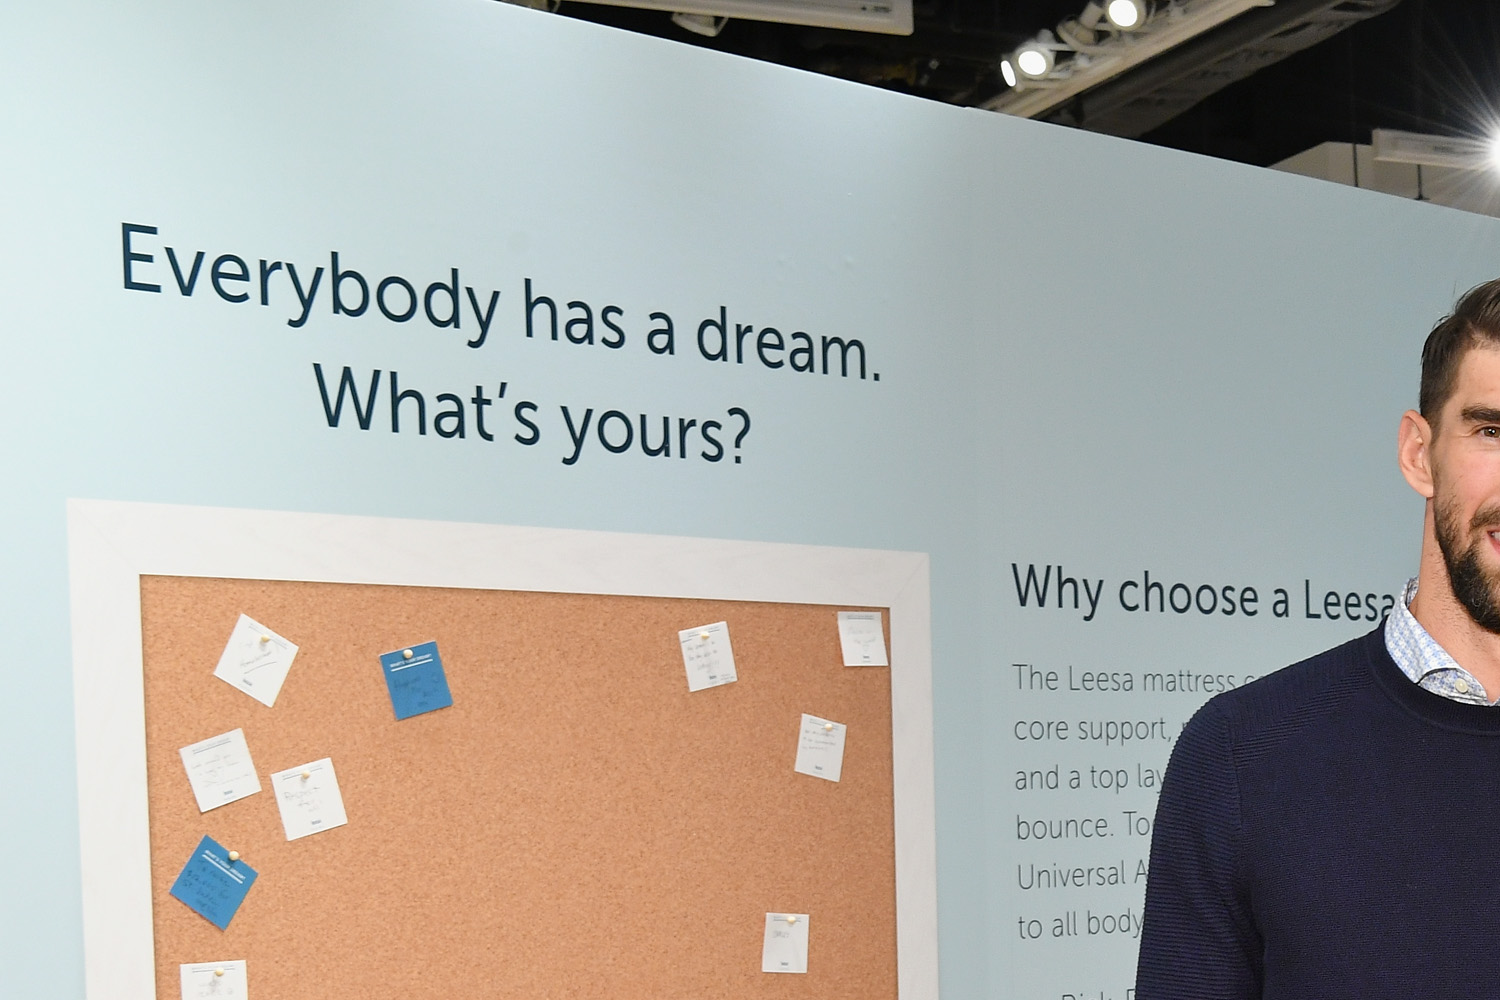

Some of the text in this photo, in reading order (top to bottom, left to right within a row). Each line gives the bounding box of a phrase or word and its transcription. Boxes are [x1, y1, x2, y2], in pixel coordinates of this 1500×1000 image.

[122, 223, 879, 381] Everybody has a dream.
[313, 363, 750, 465] What's yours?
[1012, 563, 1395, 621] Why choose a Leesa
[1012, 664, 1058, 690] The
[1070, 666, 1133, 691] Leesa
[1143, 669, 1235, 692] mattress
[1015, 718, 1171, 746] core support,
[1016, 765, 1058, 790] and
[1069, 770, 1080, 789] a
[1090, 766, 1128, 794] top
[1017, 815, 1113, 840] bounce.
[1018, 860, 1125, 889] Universal
[1018, 908, 1143, 939] to all body
